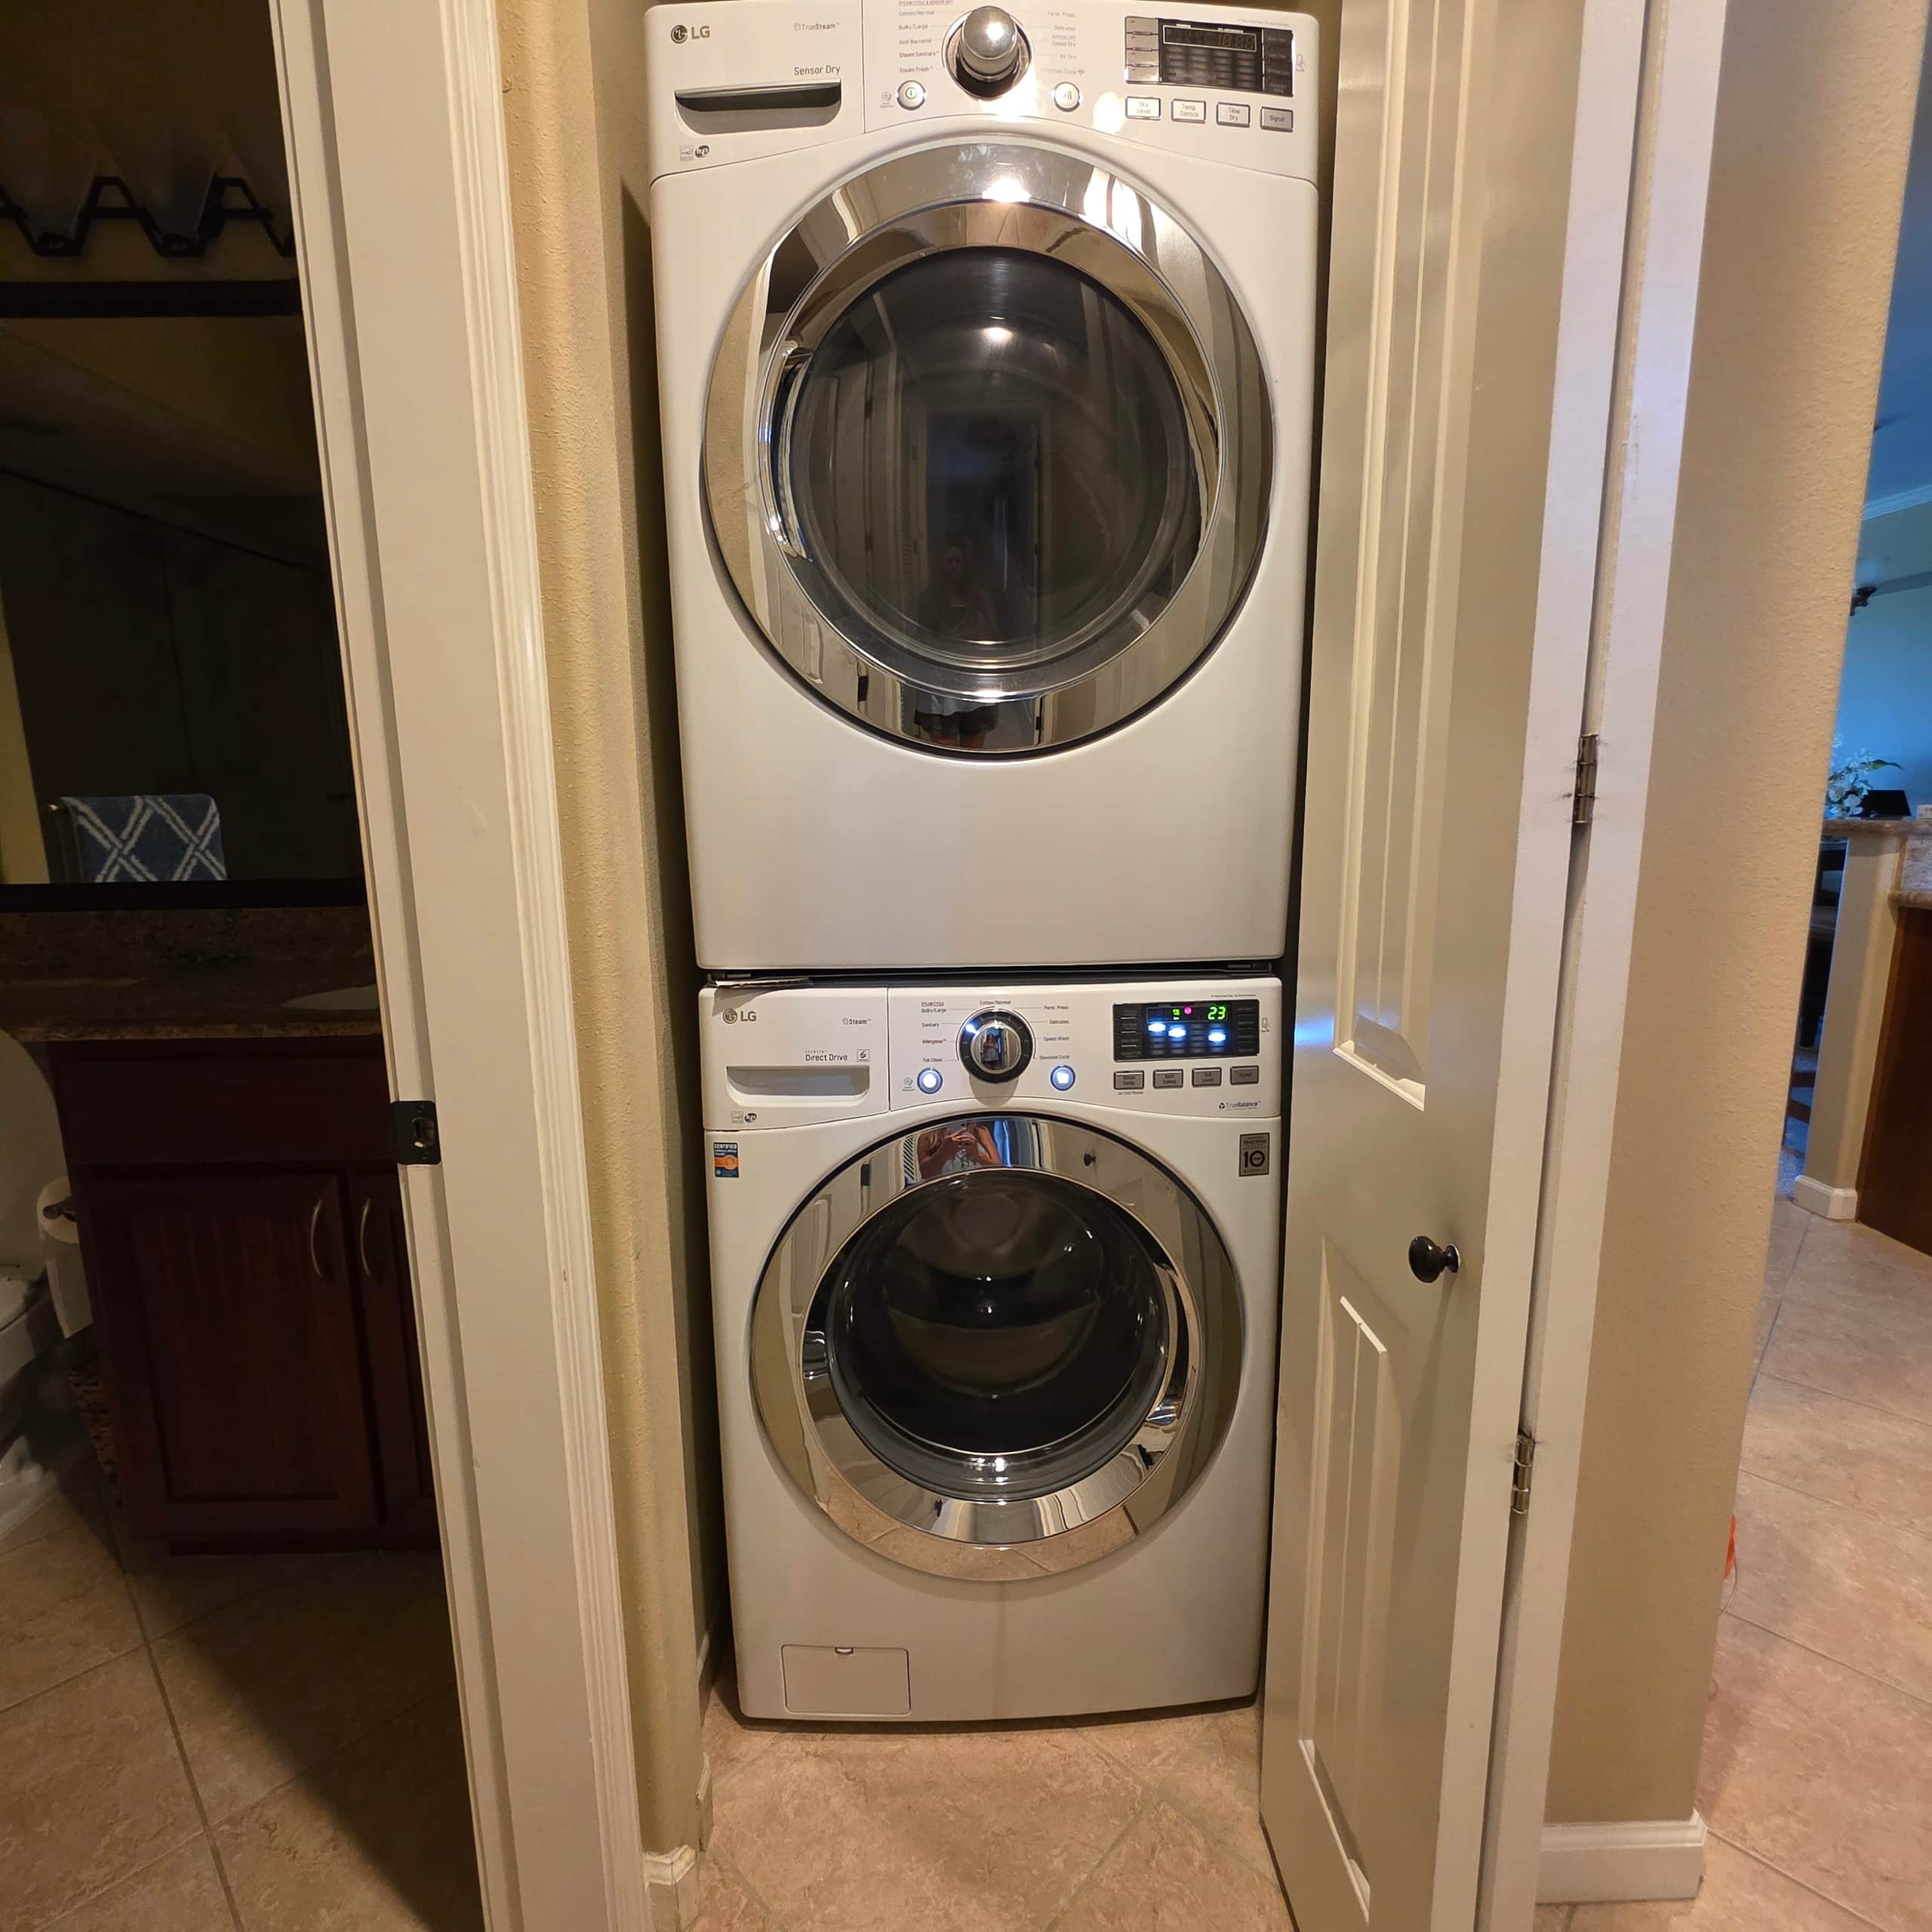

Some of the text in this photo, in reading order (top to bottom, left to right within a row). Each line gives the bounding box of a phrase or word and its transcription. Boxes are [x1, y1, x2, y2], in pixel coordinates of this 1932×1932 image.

[691, 26, 710, 39] LG
[794, 65, 841, 75] Sensor Dry
[740, 1011, 757, 1022] LG
[1208, 1006, 1226, 1020] 23
[829, 1053, 848, 1061] Drive
[1244, 1150, 1266, 1168] 10
